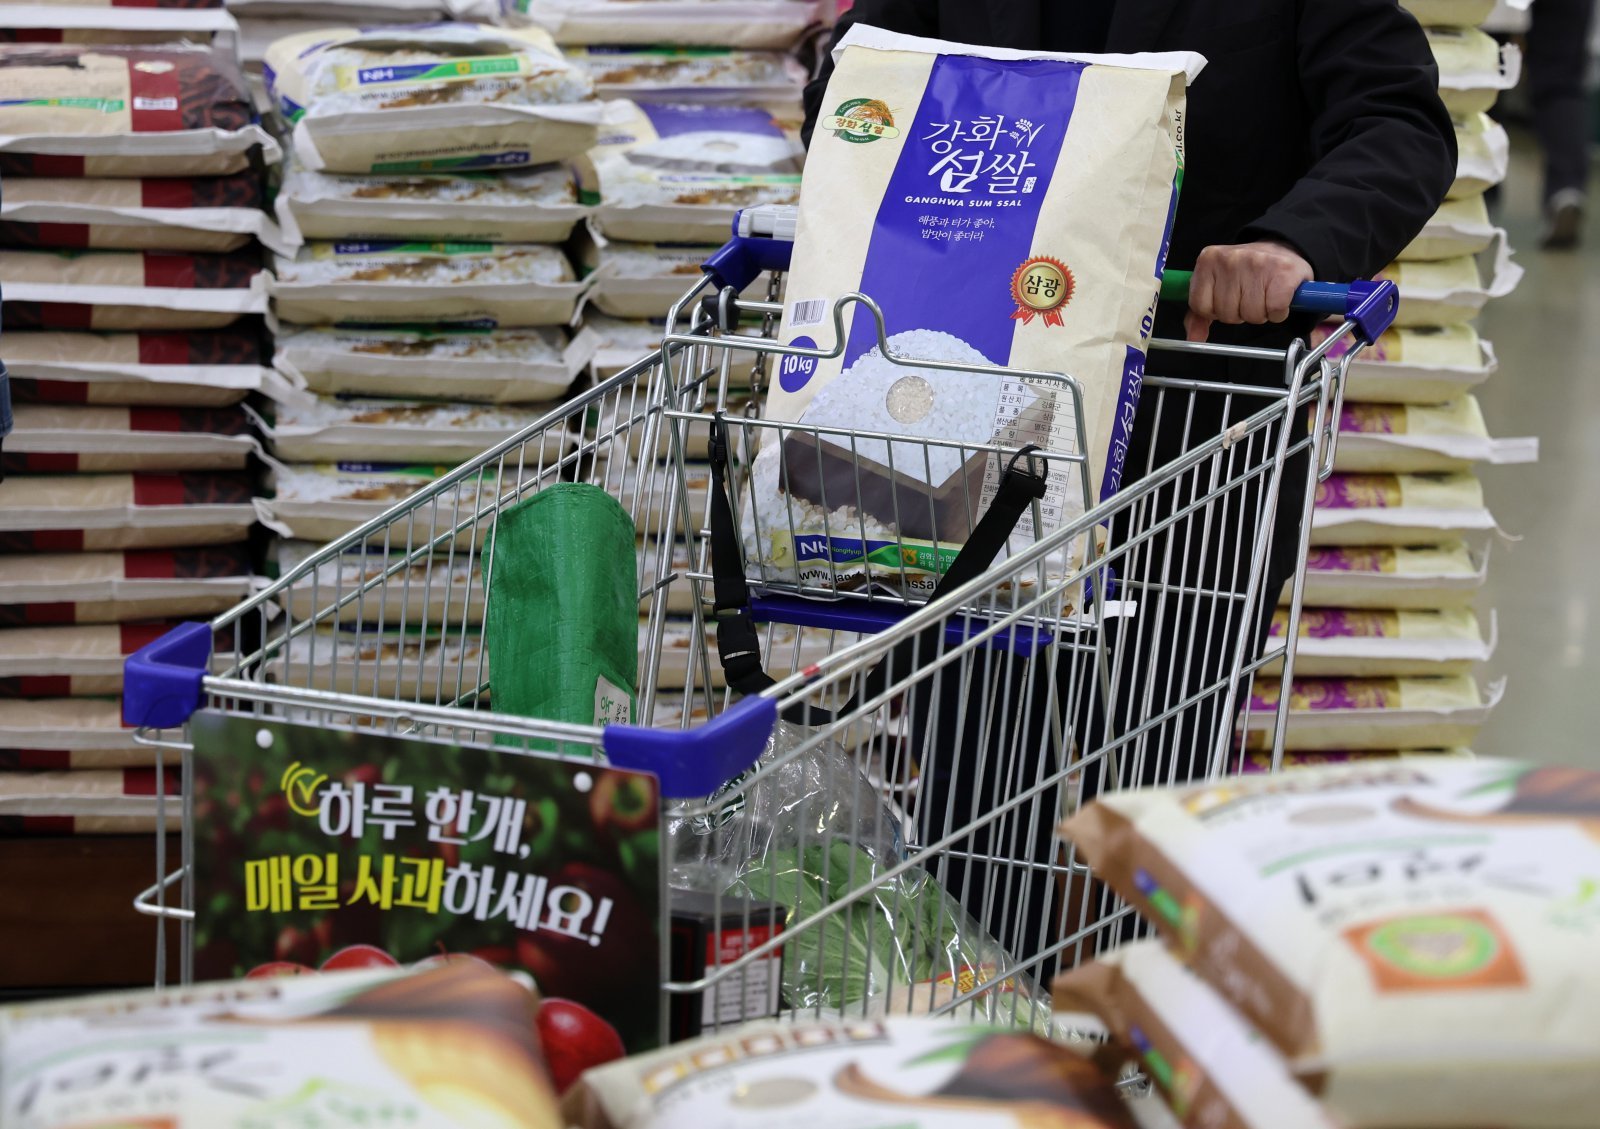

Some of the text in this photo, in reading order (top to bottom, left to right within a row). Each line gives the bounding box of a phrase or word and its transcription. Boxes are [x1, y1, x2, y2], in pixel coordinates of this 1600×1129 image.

[922, 115, 1008, 154] 강화
[928, 150, 1036, 194] 섬쌀
[904, 196, 964, 207] GANGHWA
[918, 215, 995, 229] 해풍과 터가 좋아,
[921, 229, 985, 241] 밥맛이 좋더라
[1024, 275, 1061, 298] 삼광
[319, 782, 531, 859] 하루 한개,
[244, 853, 614, 947] 매일 사과하세요!
